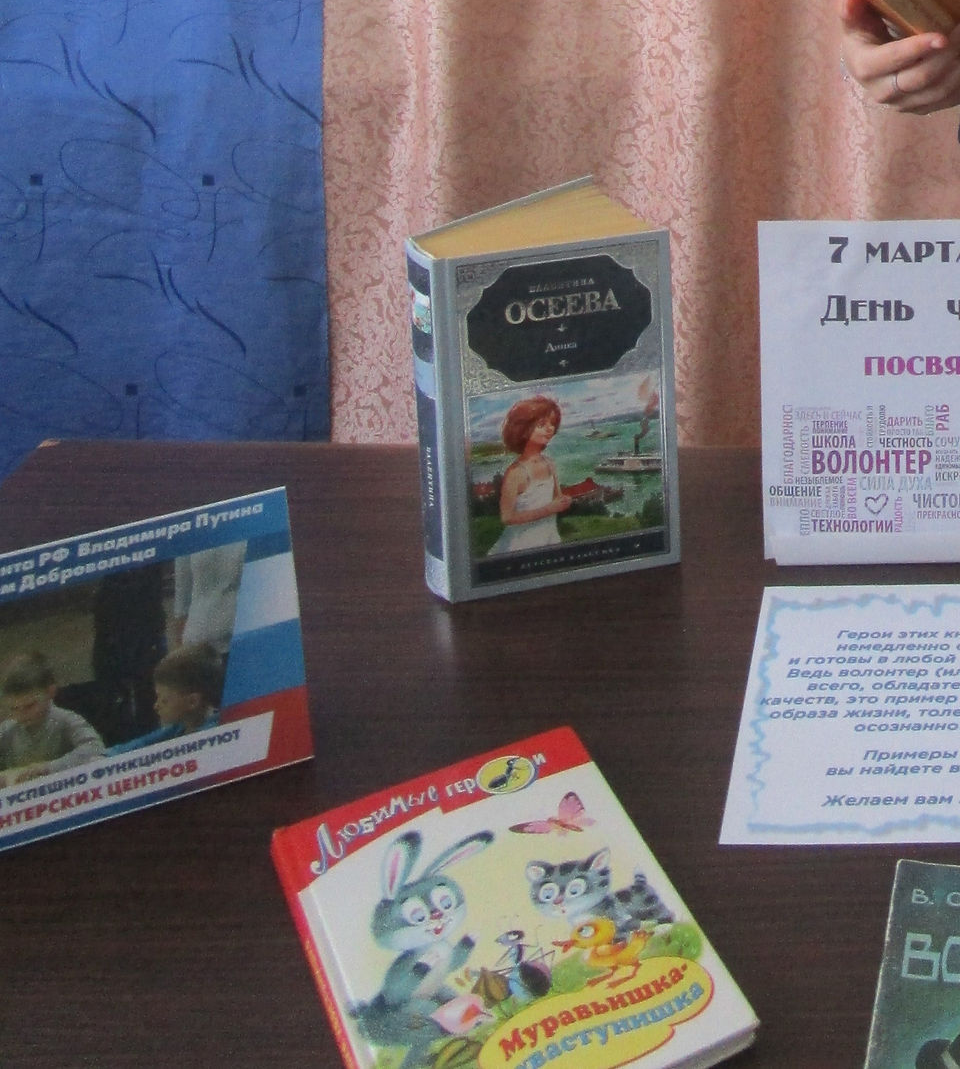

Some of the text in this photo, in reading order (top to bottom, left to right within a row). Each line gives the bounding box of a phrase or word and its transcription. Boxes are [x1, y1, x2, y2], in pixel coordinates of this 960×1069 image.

[828, 236, 849, 264] 7
[505, 288, 622, 325] ОСЕЕВА
[812, 420, 848, 429] ТЕРПЕНИЕ
[887, 416, 923, 428] ДАРИТЬ
[935, 404, 950, 432] РАБ
[812, 435, 856, 448] ШКОЛА
[880, 437, 933, 448] ЧЕСТНОСТЬ
[812, 449, 932, 475] ВОЛОНТЕР
[795, 476, 844, 485] НЕЗЫБЛЕМОЕ
[860, 475, 932, 493] СИЛА ДУХА
[769, 485, 822, 498] ОБЩЕНИЕ
[847, 477, 857, 504] ВСЕМ
[811, 510, 845, 518] СВЕТЛОЕ
[811, 519, 894, 533] ТЕХНОЛОГИИ
[39, 547, 69, 567] РФ
[77, 519, 192, 558] Владимира
[195, 502, 264, 529] Путина
[19, 546, 157, 594] Добровольца
[836, 629, 894, 641] Герои
[898, 630, 940, 639] этих
[835, 642, 951, 652] немедленно
[787, 657, 800, 665] и
[805, 655, 873, 665] готовы
[877, 655, 888, 664] в
[892, 653, 957, 664] любой
[786, 668, 834, 679] Ведь
[838, 667, 929, 678] волонтер
[806, 681, 865, 692] всего,
[760, 694, 840, 706] качеств,
[845, 695, 879, 705] это
[884, 693, 958, 705] пример
[769, 708, 839, 721] образа
[842, 708, 912, 719] жизни,
[862, 749, 958, 762] Примеры
[6, 728, 241, 807] УСПЕШНО ФУНКЦИОНИРУЮТ
[825, 766, 853, 776] вы
[859, 763, 943, 776] найдете
[948, 764, 960, 773] в
[107, 759, 199, 798] ЦЕНТРОВ
[820, 794, 910, 807] Желаем
[914, 794, 954, 805] вам
[911, 888, 935, 906] В.
